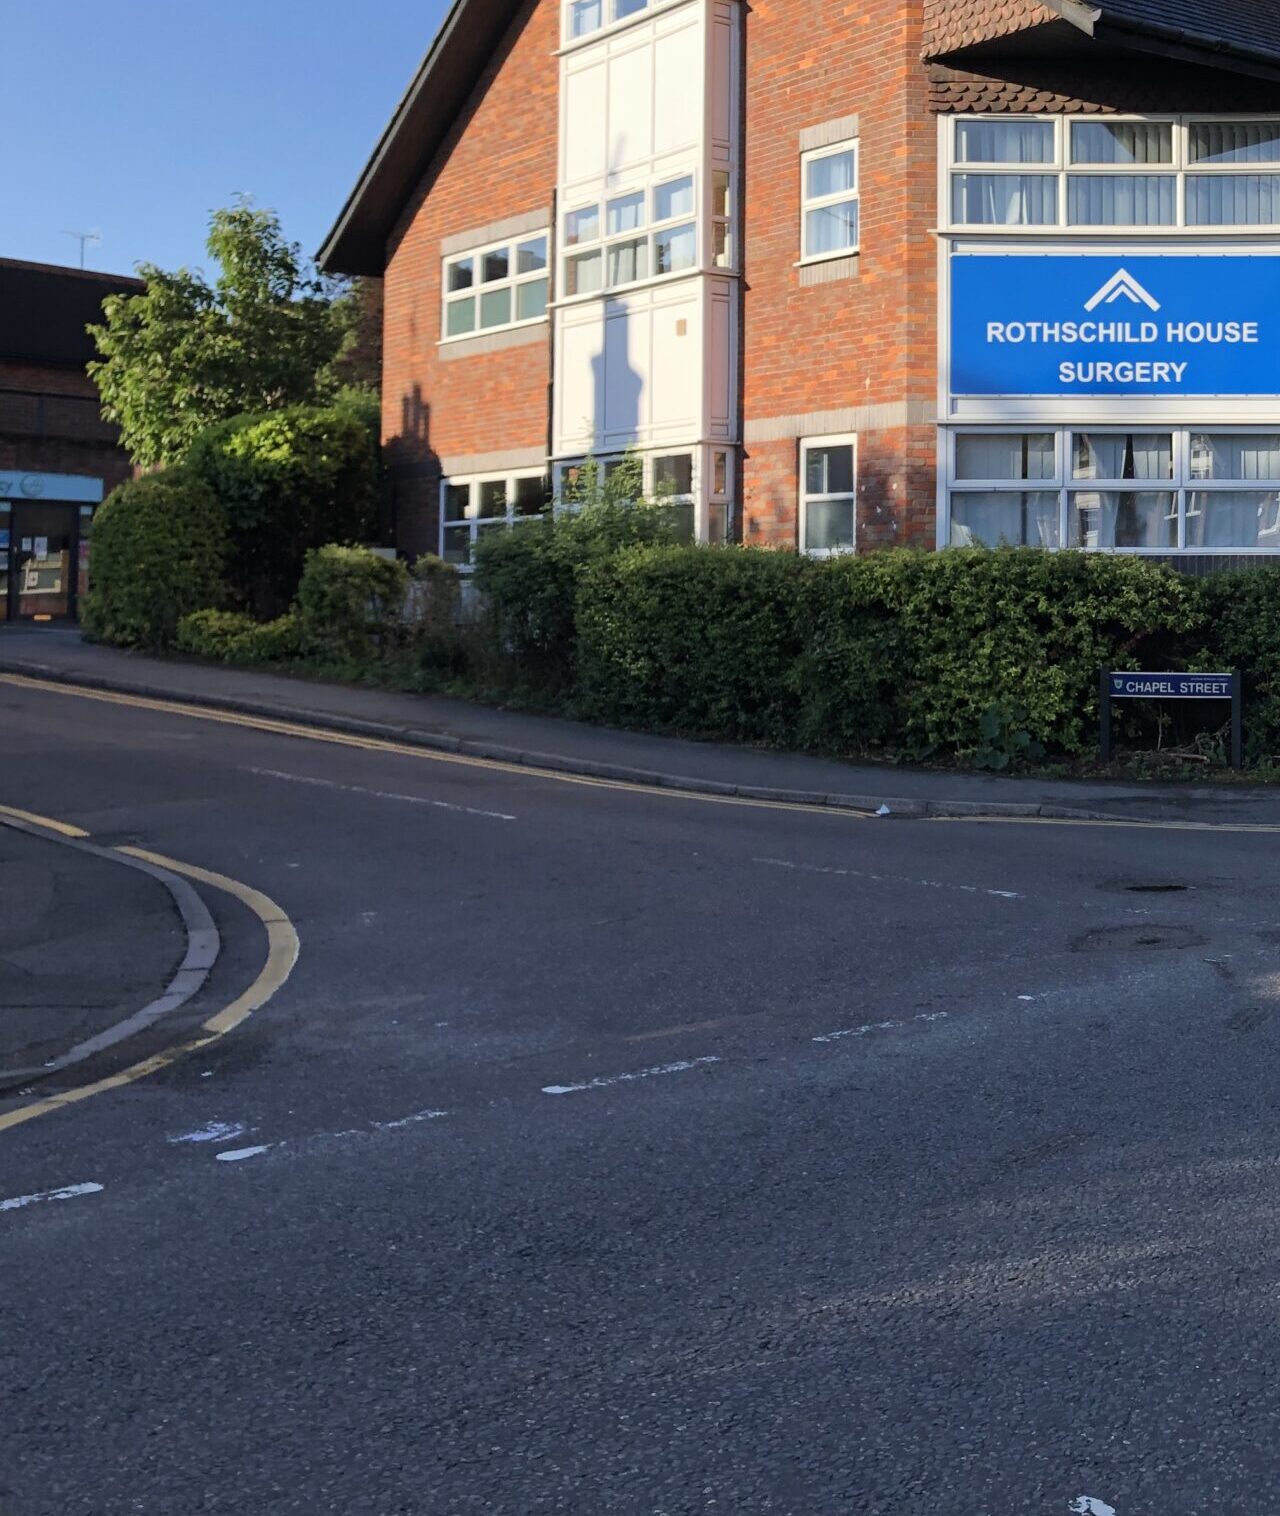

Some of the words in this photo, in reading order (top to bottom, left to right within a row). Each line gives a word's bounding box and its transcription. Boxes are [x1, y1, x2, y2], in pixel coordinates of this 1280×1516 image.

[986, 321, 1158, 343] ROTHSCHILD
[1166, 321, 1259, 343] HOUSE
[1058, 361, 1188, 383] SURGERY
[1126, 681, 1175, 693] CHAPEL
[1180, 682, 1228, 694] STREET
